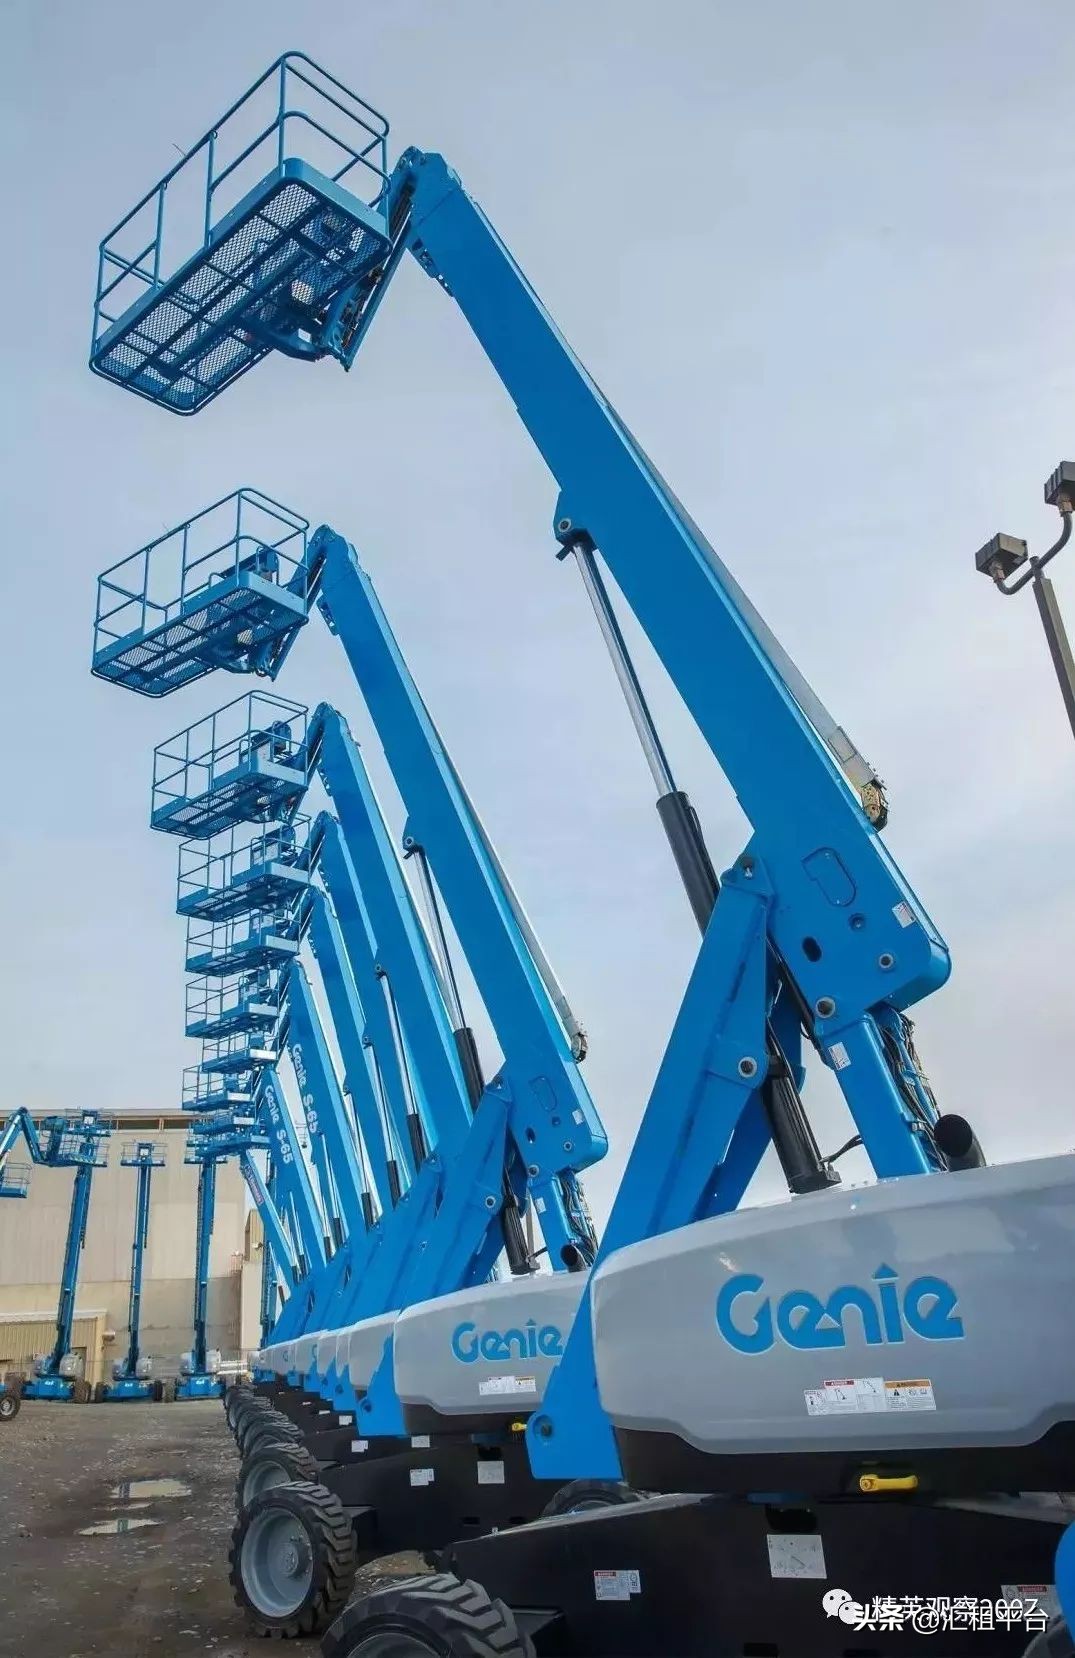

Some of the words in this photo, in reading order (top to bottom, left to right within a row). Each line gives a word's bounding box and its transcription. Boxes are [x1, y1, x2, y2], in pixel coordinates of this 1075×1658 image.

[265, 1085, 280, 1124] Genie
[277, 1129, 293, 1164] S-65
[293, 1044, 307, 1089] Genie
[303, 1094, 318, 1133] S-65
[451, 1318, 564, 1365] Genie
[716, 1263, 965, 1355] Genie
